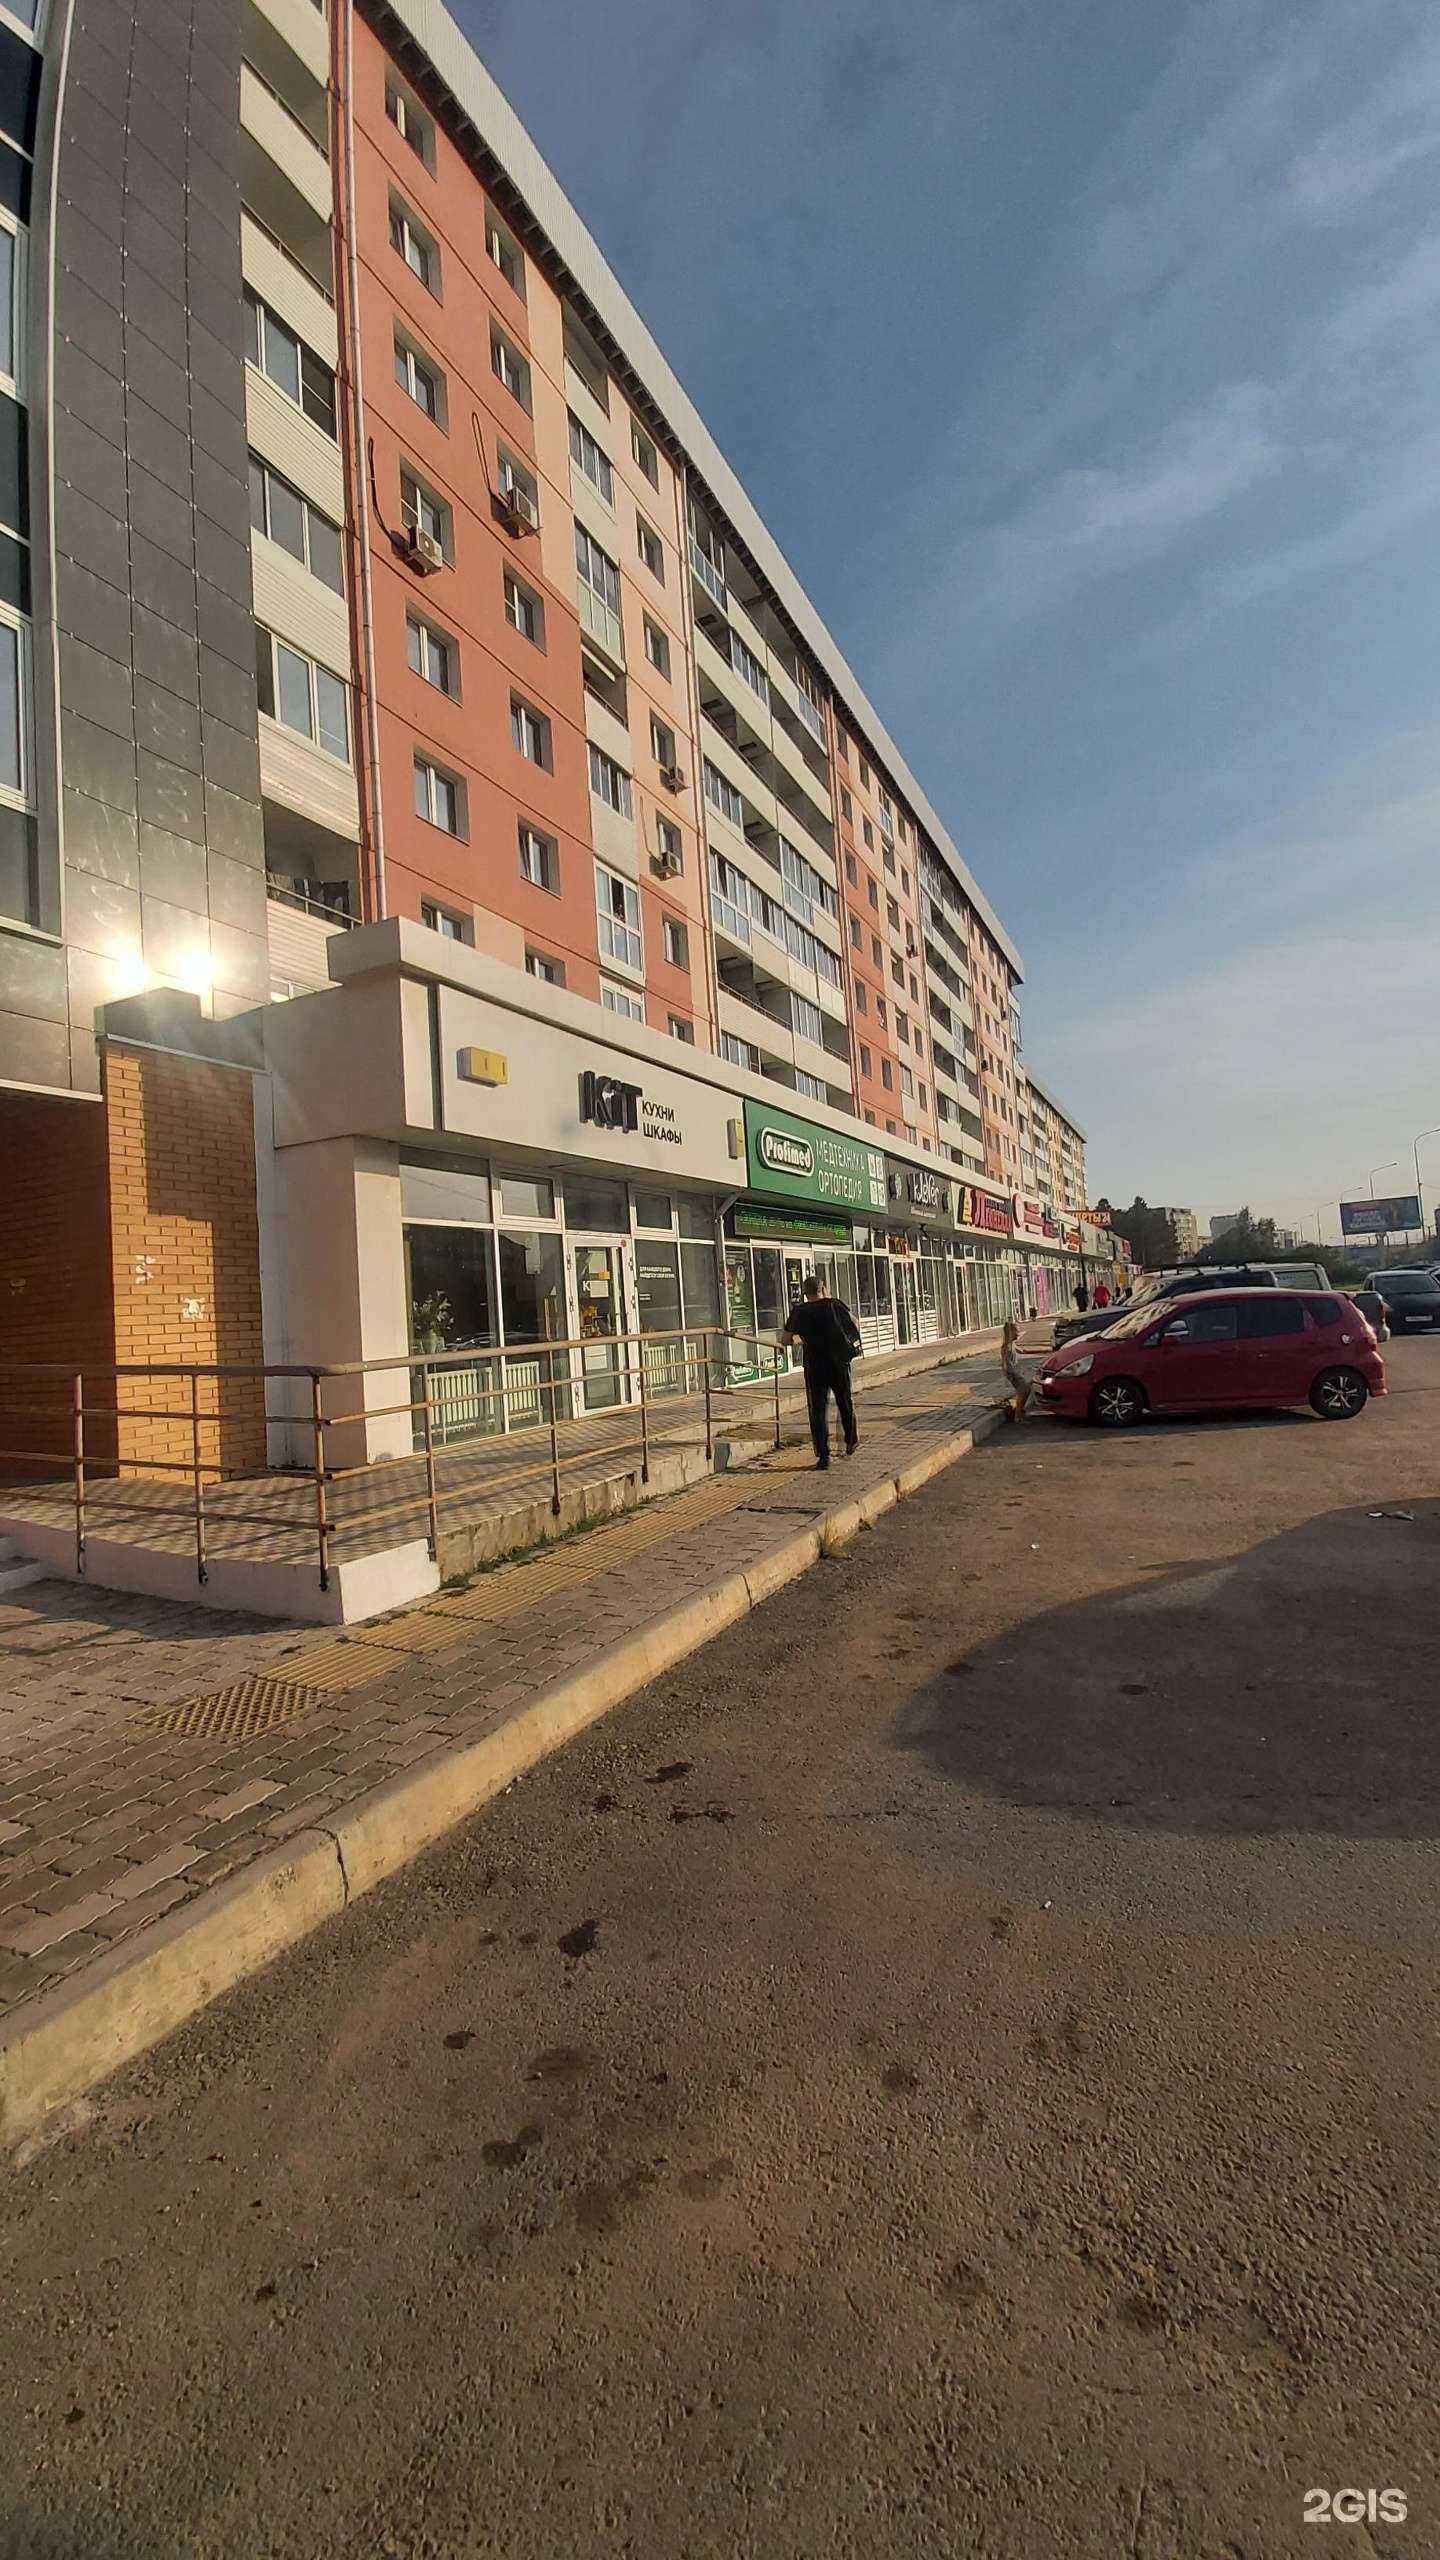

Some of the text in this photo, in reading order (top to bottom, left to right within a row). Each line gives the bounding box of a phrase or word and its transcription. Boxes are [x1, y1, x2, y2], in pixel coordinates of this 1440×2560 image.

[642, 1100, 675, 1122] КУХНИ
[643, 1122, 682, 1145] ШКАФЫ
[764, 1134, 811, 1168] Profimed
[815, 1138, 865, 1170] МЕДТЕХНИКА
[818, 1169, 862, 1202] ОРТОПЕДИЯ
